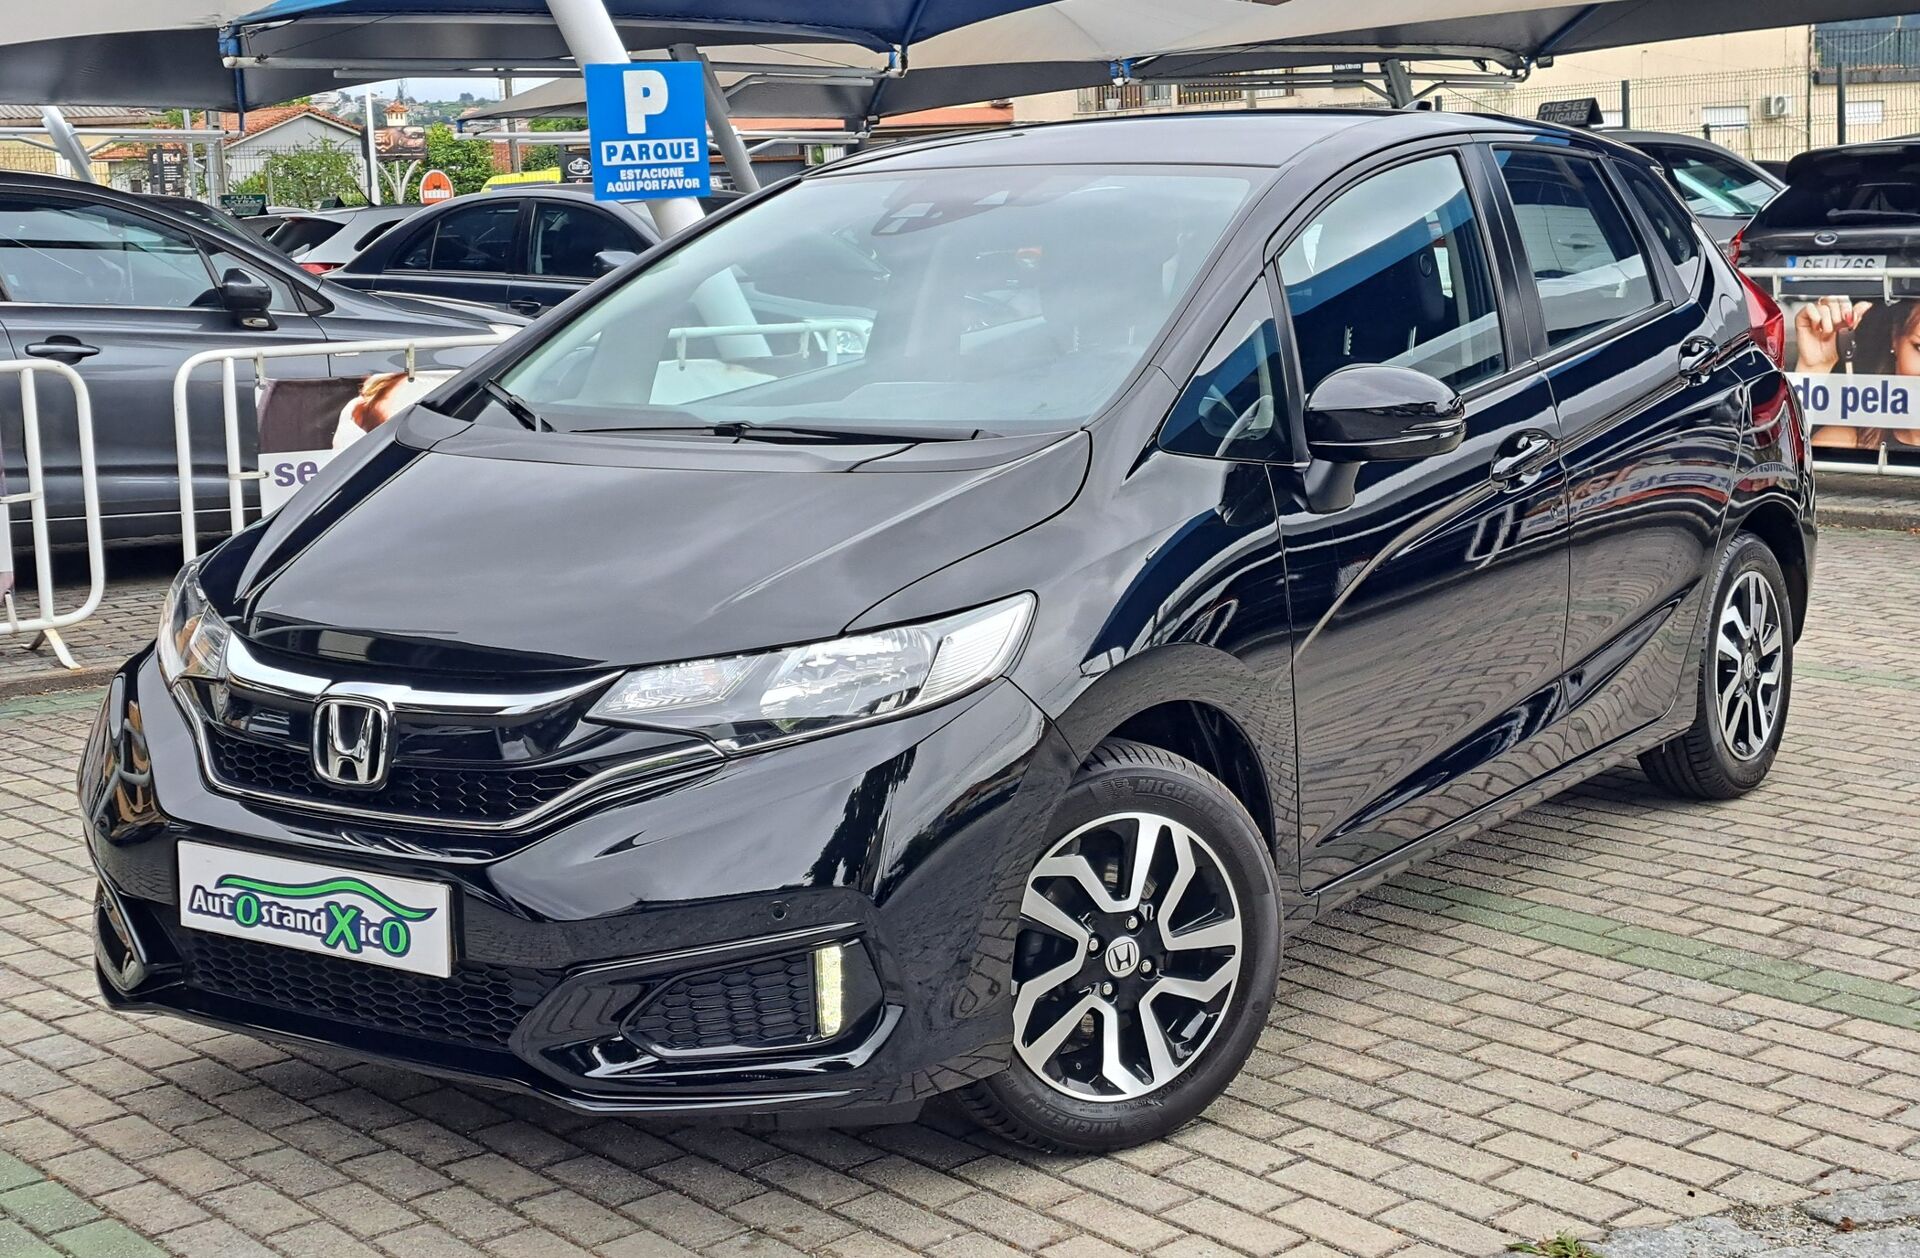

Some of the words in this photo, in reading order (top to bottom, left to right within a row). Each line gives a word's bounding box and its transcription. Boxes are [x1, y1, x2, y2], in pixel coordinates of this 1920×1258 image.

[623, 70, 668, 134] P
[1540, 100, 1589, 113] DIESEL
[605, 141, 696, 162] PARQUE
[619, 167, 685, 181] ESTACIONE
[606, 181, 636, 194] AQUI
[636, 179, 661, 192] POR
[661, 177, 701, 191] FAVOR
[1840, 380, 1909, 420] pela
[274, 461, 319, 487] se
